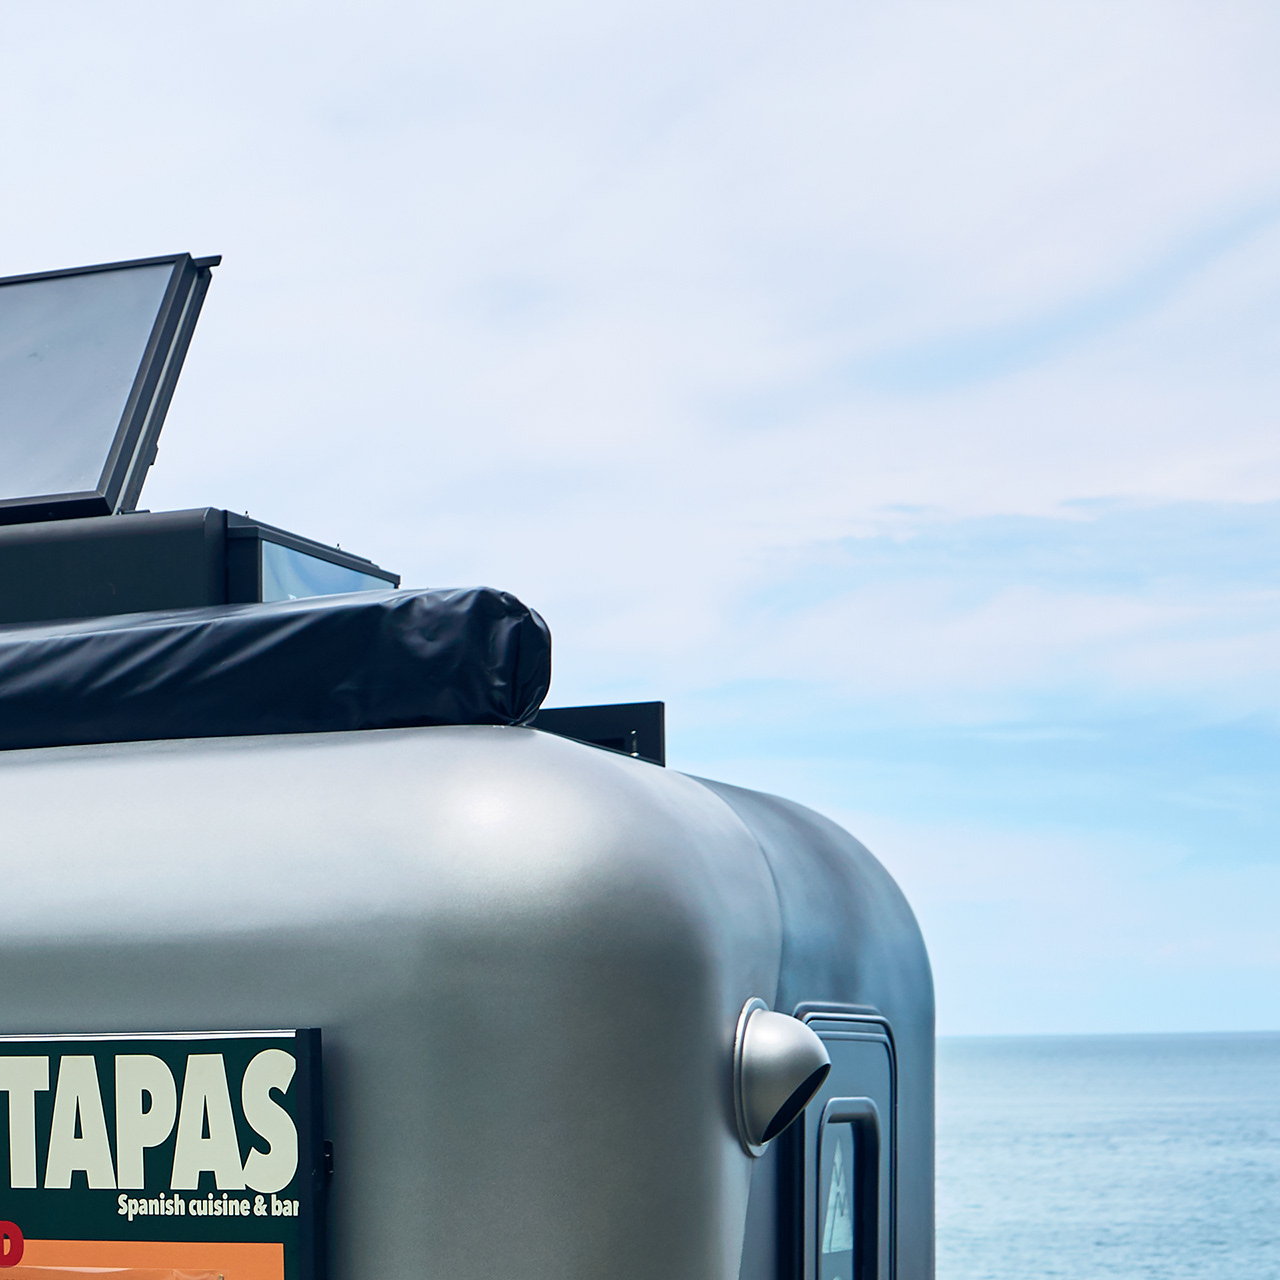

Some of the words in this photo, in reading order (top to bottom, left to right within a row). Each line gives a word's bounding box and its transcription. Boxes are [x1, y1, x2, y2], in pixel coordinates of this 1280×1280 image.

[117, 1193, 186, 1221] Spanish
[188, 1195, 251, 1217] cuisine
[253, 1196, 268, 1217] &
[270, 1196, 299, 1218] bar
